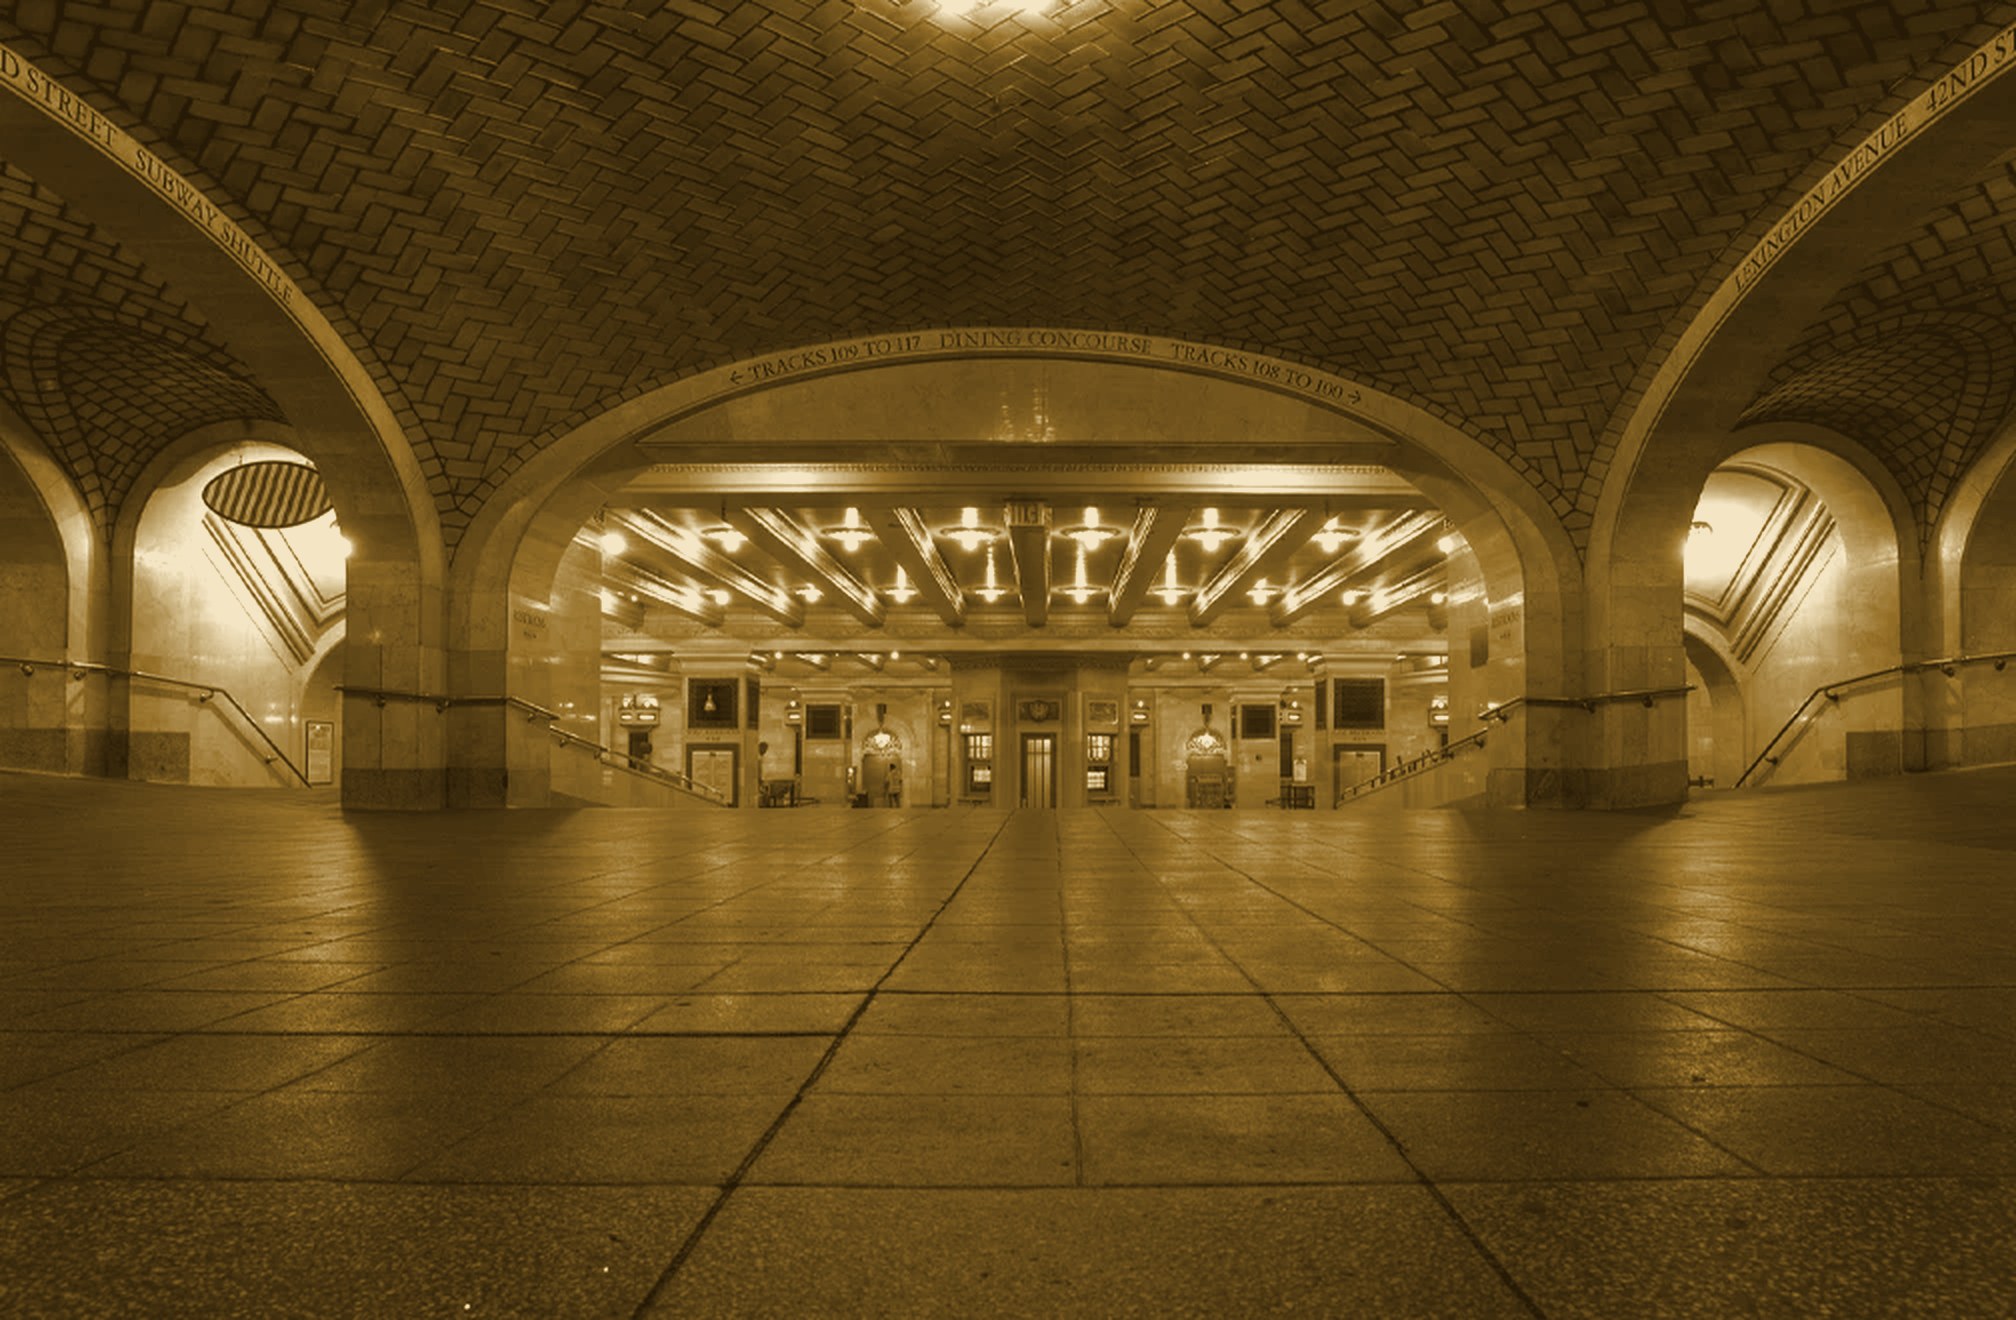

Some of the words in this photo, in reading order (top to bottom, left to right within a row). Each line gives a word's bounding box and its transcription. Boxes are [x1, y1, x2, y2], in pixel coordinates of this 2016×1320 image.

[27, 68, 117, 148] STREET
[1926, 51, 1987, 111] 42ND
[135, 149, 218, 227] SUBWAY
[221, 222, 293, 305] SHUTTLE
[1735, 187, 1828, 293] LEXINGTON
[1829, 111, 1909, 195] AVENUE
[748, 348, 827, 380] TRACKS
[832, 345, 859, 362] 109
[864, 339, 891, 356] TO
[897, 335, 921, 351] 117
[939, 330, 1021, 349] DINING
[1027, 330, 1153, 354] CONCOURSE
[1171, 342, 1248, 371] TRACKS
[1252, 357, 1281, 379] 108
[1286, 368, 1312, 389] TO
